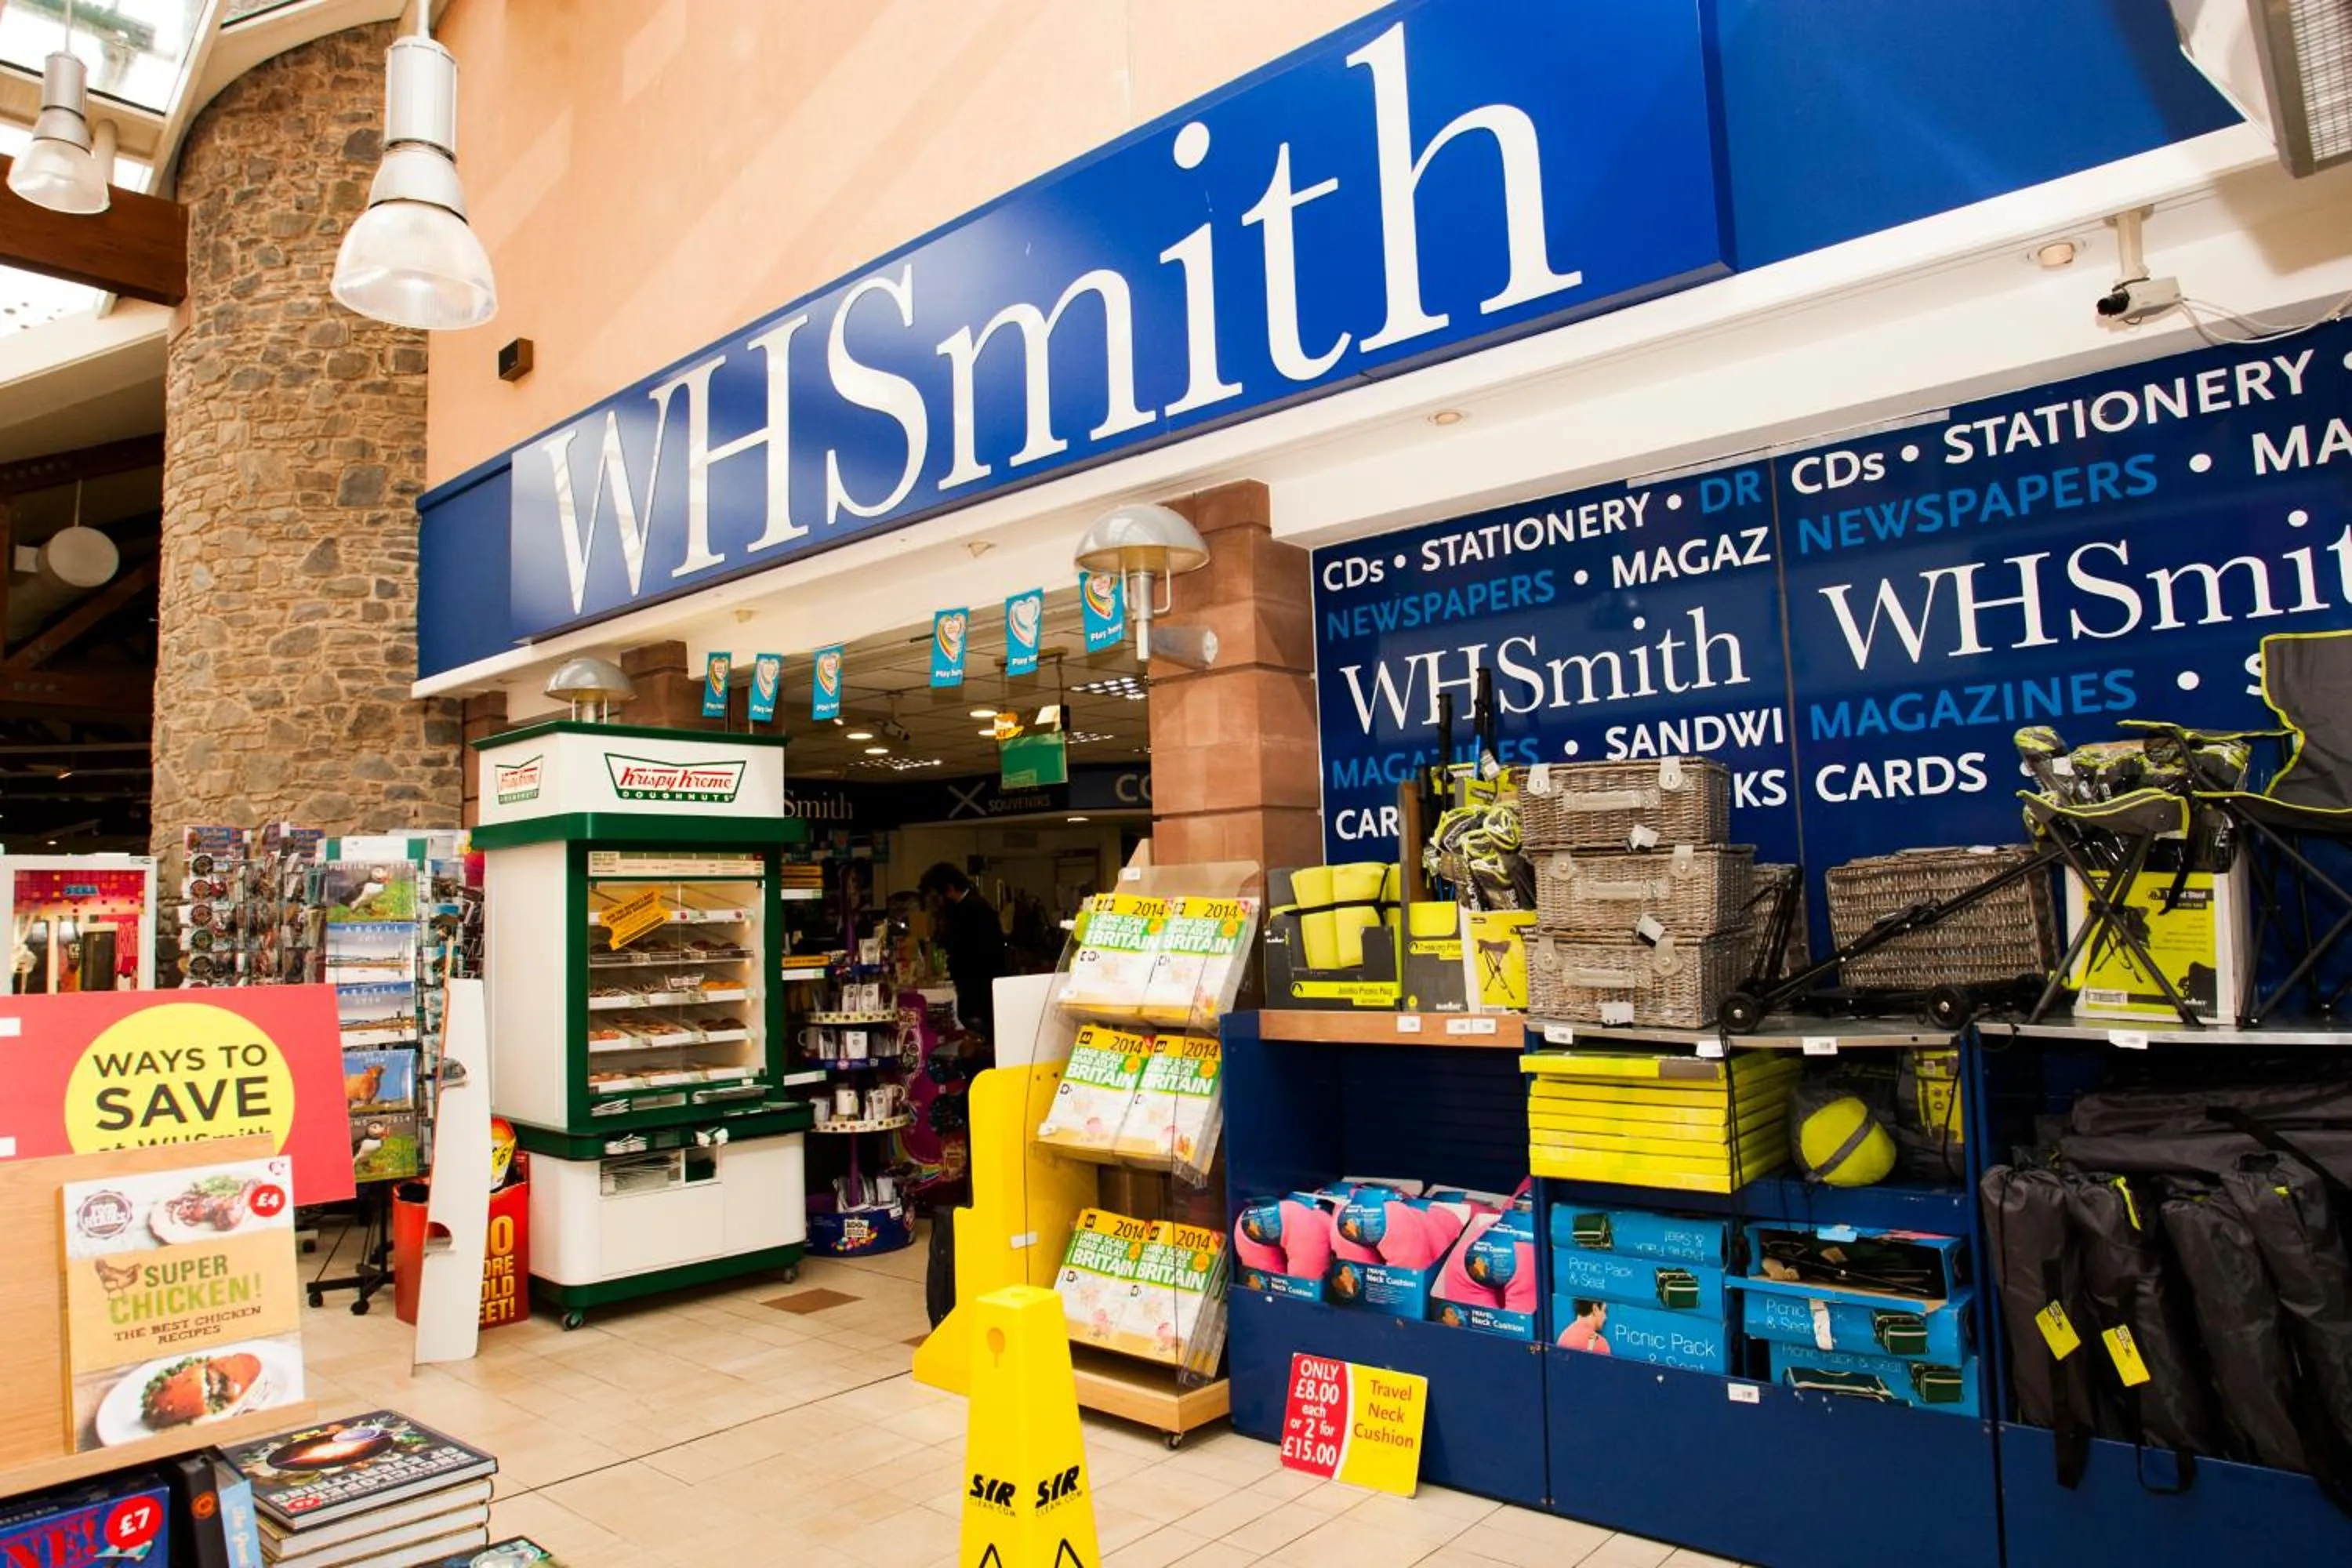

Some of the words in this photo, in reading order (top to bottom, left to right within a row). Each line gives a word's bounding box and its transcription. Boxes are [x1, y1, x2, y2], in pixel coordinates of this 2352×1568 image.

[545, 22, 1582, 615] WHSmith
[1791, 451, 1884, 494] CDs
[1943, 349, 2314, 464] STATIONERY
[1797, 454, 2158, 554] NEWSPAPERS
[1323, 555, 1385, 592] CDs
[1421, 492, 1650, 572] STATIONERY
[1700, 469, 1761, 514] DR
[1327, 568, 1555, 641] NEWSPAPERS
[1612, 527, 1771, 589] MAGAZ
[1339, 606, 1750, 735] WHSmith
[1810, 669, 2137, 741] MAGAZINES
[1606, 708, 1783, 761] SANDWI
[619, 766, 678, 792] Krispy
[678, 769, 734, 789] Kreme
[1734, 769, 1788, 808] KS
[1816, 752, 1987, 802] CARDS
[622, 791, 731, 803] DOUGHNUTS
[783, 789, 854, 820] Smith
[988, 794, 1051, 813] SOUVENIRS
[1335, 805, 1399, 840] CAR
[1132, 901, 1165, 917] 2014
[1204, 903, 1239, 919] 2014
[1090, 931, 1161, 952] BRITAIN
[1163, 933, 1236, 953] BRITAIN
[1109, 1036, 1144, 1054] 2014
[1185, 1042, 1218, 1058] 2014
[93, 1047, 204, 1079] WAYS
[220, 1044, 268, 1069] TO
[1066, 1062, 1138, 1088] BRITAIN
[1138, 1072, 1214, 1095] BRITAIN
[95, 1075, 272, 1131] SAVE
[257, 1192, 279, 1208] £4
[1113, 1220, 1145, 1240] 2014
[1177, 1229, 1211, 1250] 2014
[144, 1254, 229, 1287] SUPER
[1072, 1248, 1137, 1278] BRITAIN
[1138, 1261, 1206, 1290] BRITAIN
[1569, 1257, 1602, 1275] Picnic
[1604, 1261, 1633, 1278] Pack
[1366, 1274, 1385, 1284] Neck
[1386, 1276, 1417, 1289] Cushion
[1569, 1273, 1579, 1286] &
[1581, 1274, 1606, 1290] Seat
[108, 1272, 262, 1326] CHICKEN!
[1766, 1298, 1806, 1319] Picnic
[114, 1327, 147, 1342] THE
[151, 1319, 190, 1335] BEST
[194, 1306, 262, 1327] CHICKEN
[158, 1324, 221, 1345] RECIPES
[1472, 1316, 1491, 1327] Neck
[1492, 1320, 1526, 1333] Cushion
[1615, 1323, 1665, 1350] Picnic
[1671, 1333, 1716, 1358] Pack
[1300, 1359, 1340, 1381] ONLY
[1294, 1378, 1340, 1406] £8.00
[1370, 1379, 1413, 1402] Travel
[1301, 1403, 1327, 1418] each
[1367, 1403, 1406, 1425] Neck
[1290, 1418, 1302, 1429] or
[1304, 1418, 1316, 1439] 2
[1319, 1422, 1335, 1436] for
[1353, 1422, 1415, 1450] Cushion
[1282, 1436, 1338, 1467] £15.00
[969, 1473, 1017, 1508] SIR
[1035, 1465, 1080, 1509] SIR
[118, 1506, 151, 1538] £7
